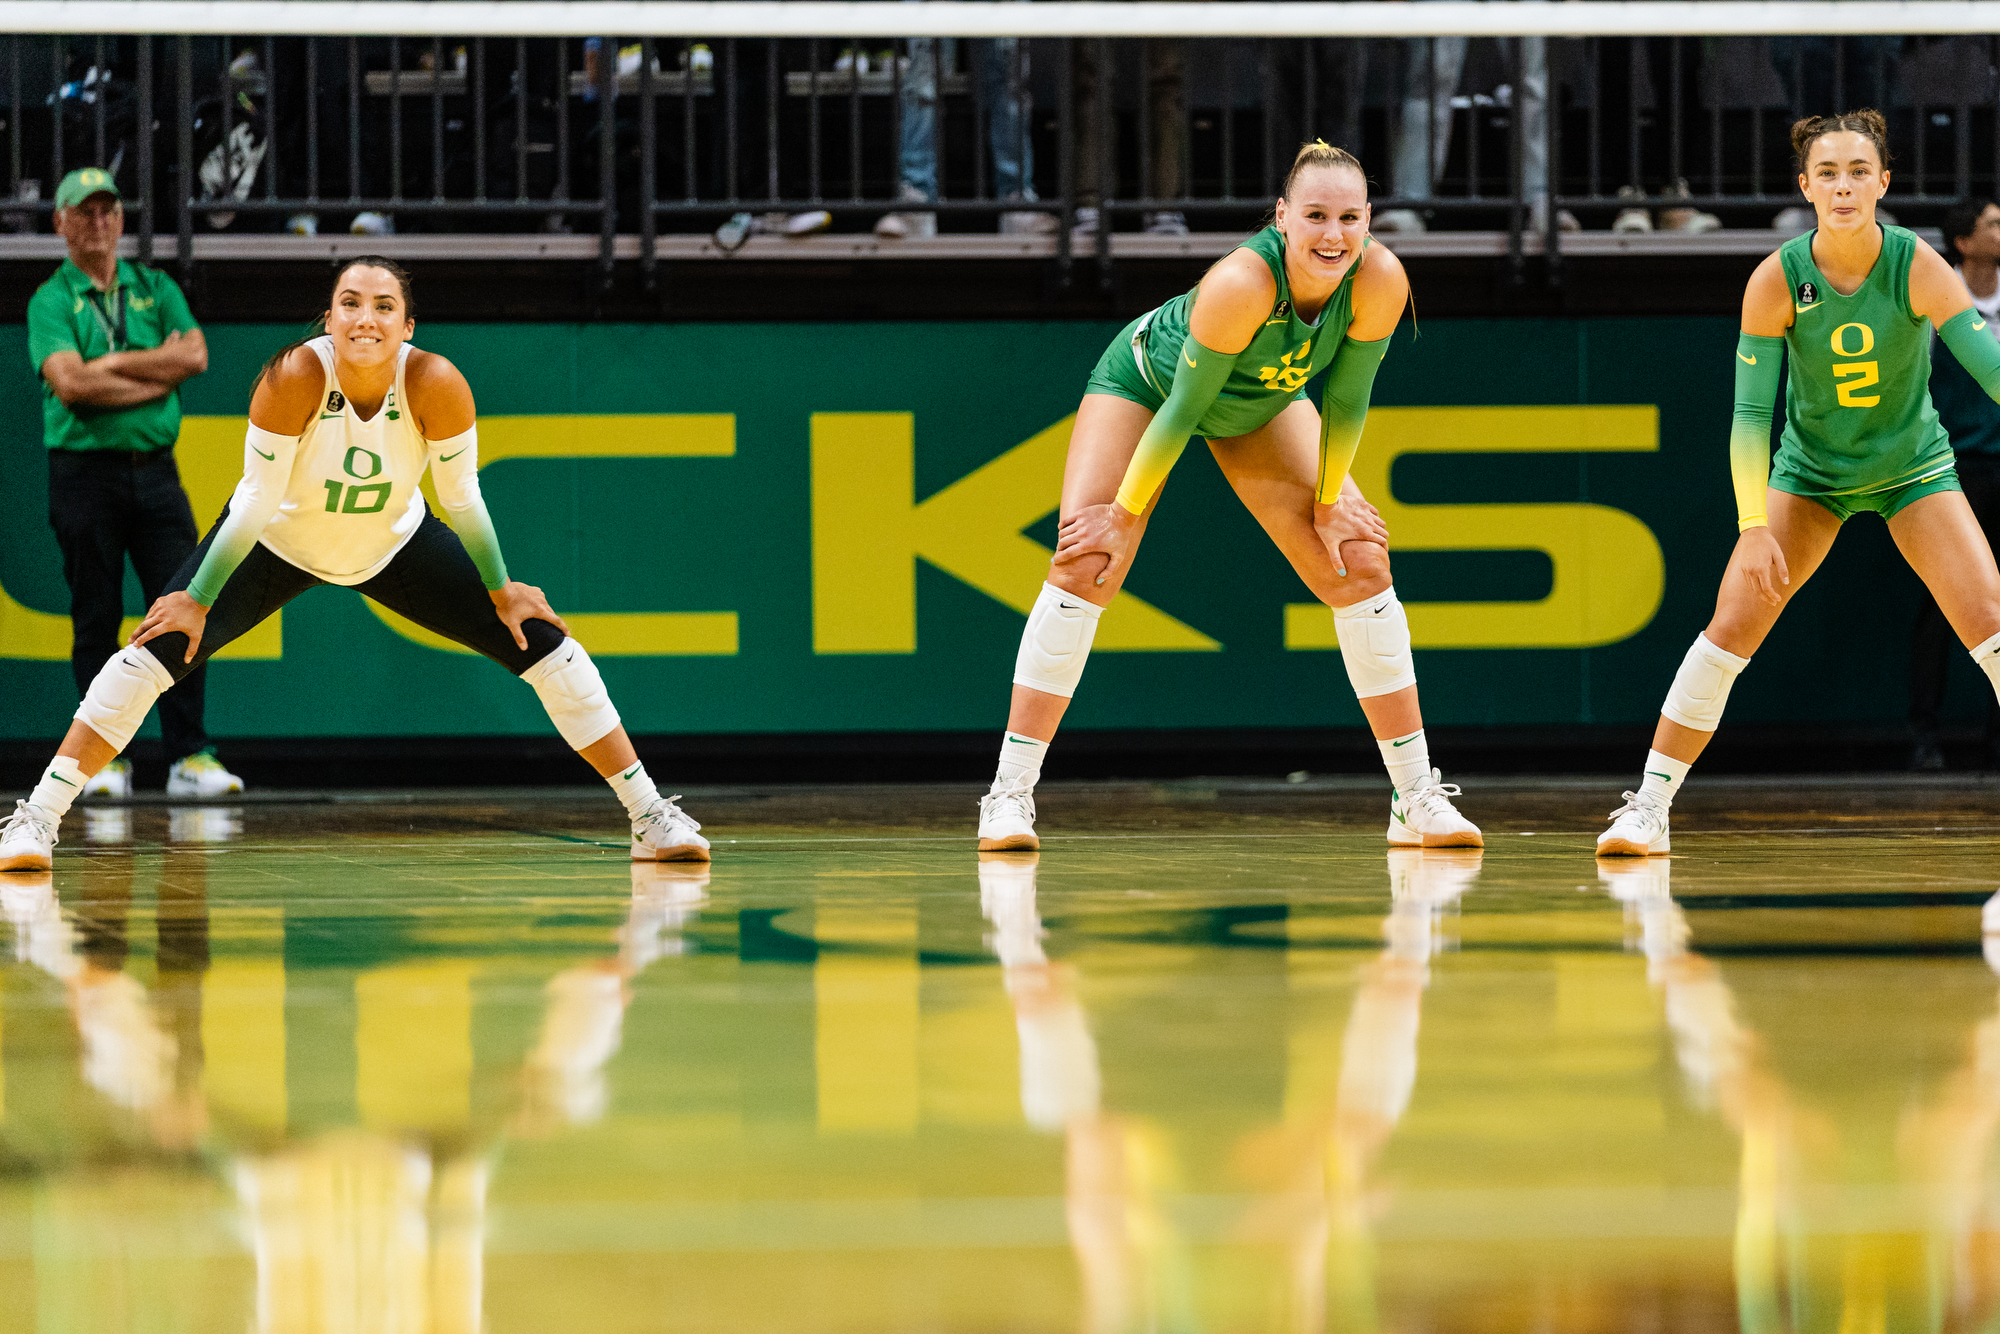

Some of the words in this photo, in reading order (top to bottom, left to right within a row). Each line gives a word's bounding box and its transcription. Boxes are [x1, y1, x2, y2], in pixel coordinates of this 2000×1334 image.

[1830, 322, 1875, 357] O
[1832, 360, 1881, 407] 2
[343, 445, 382, 480] O
[323, 478, 392, 515] 10
